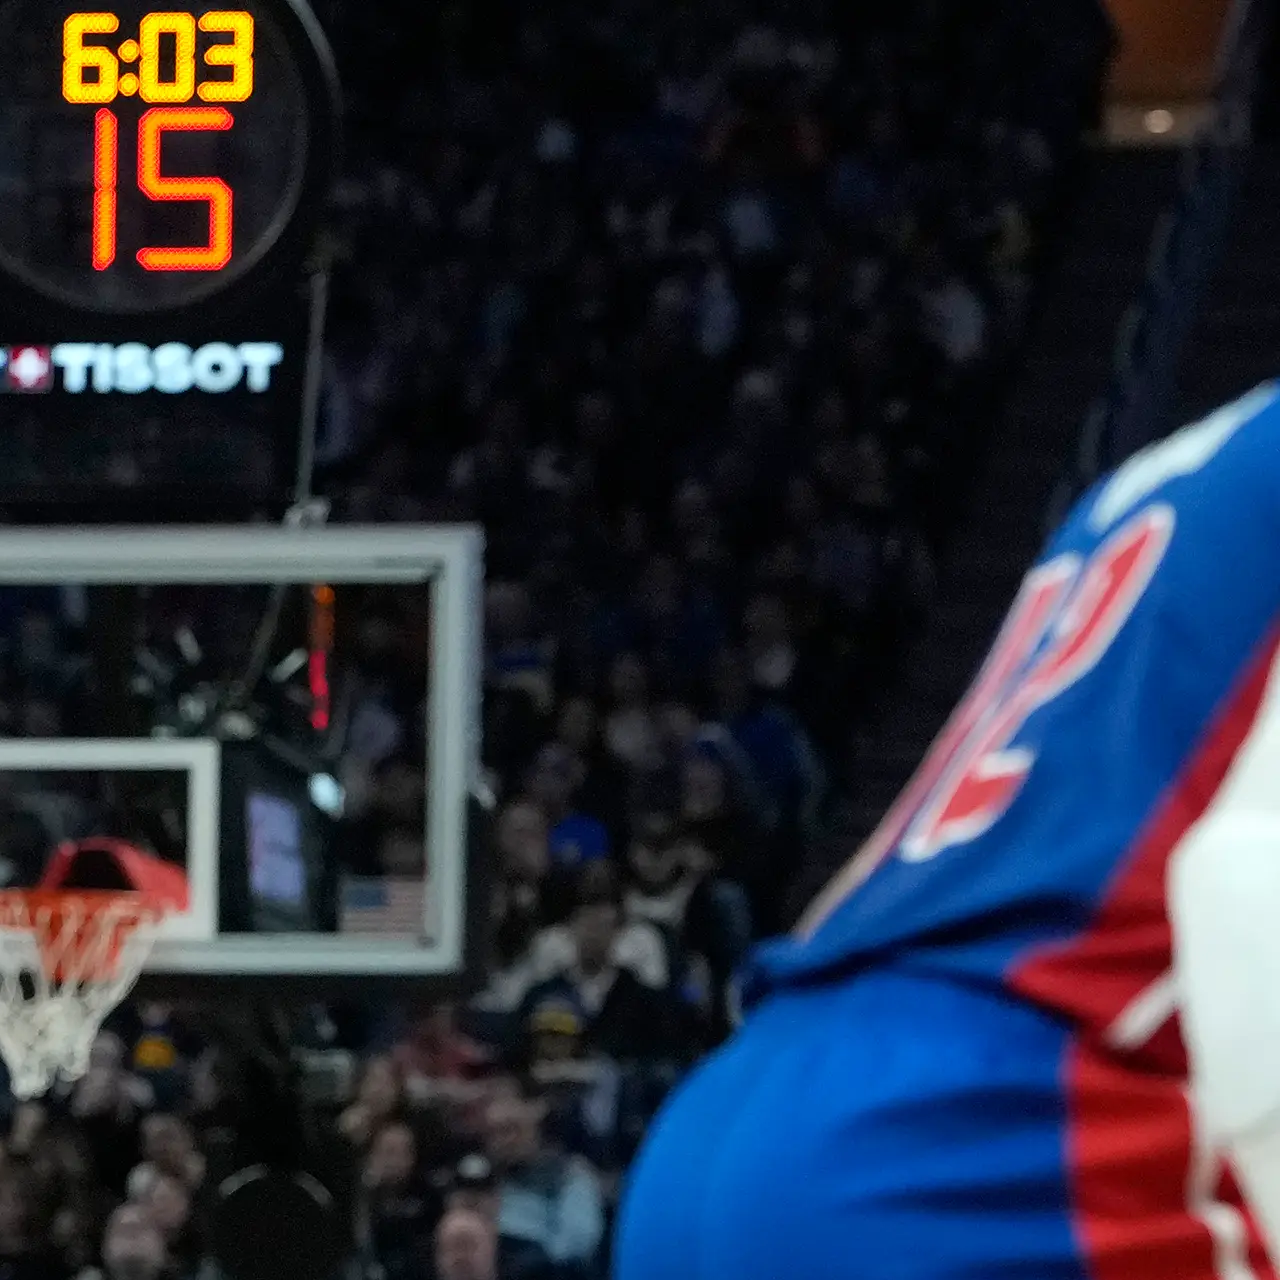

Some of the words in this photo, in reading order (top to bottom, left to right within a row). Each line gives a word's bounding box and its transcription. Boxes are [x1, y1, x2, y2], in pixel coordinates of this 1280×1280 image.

[62, 11, 255, 103] 6:03
[93, 107, 234, 271] 15
[51, 341, 284, 394] TISSOT
